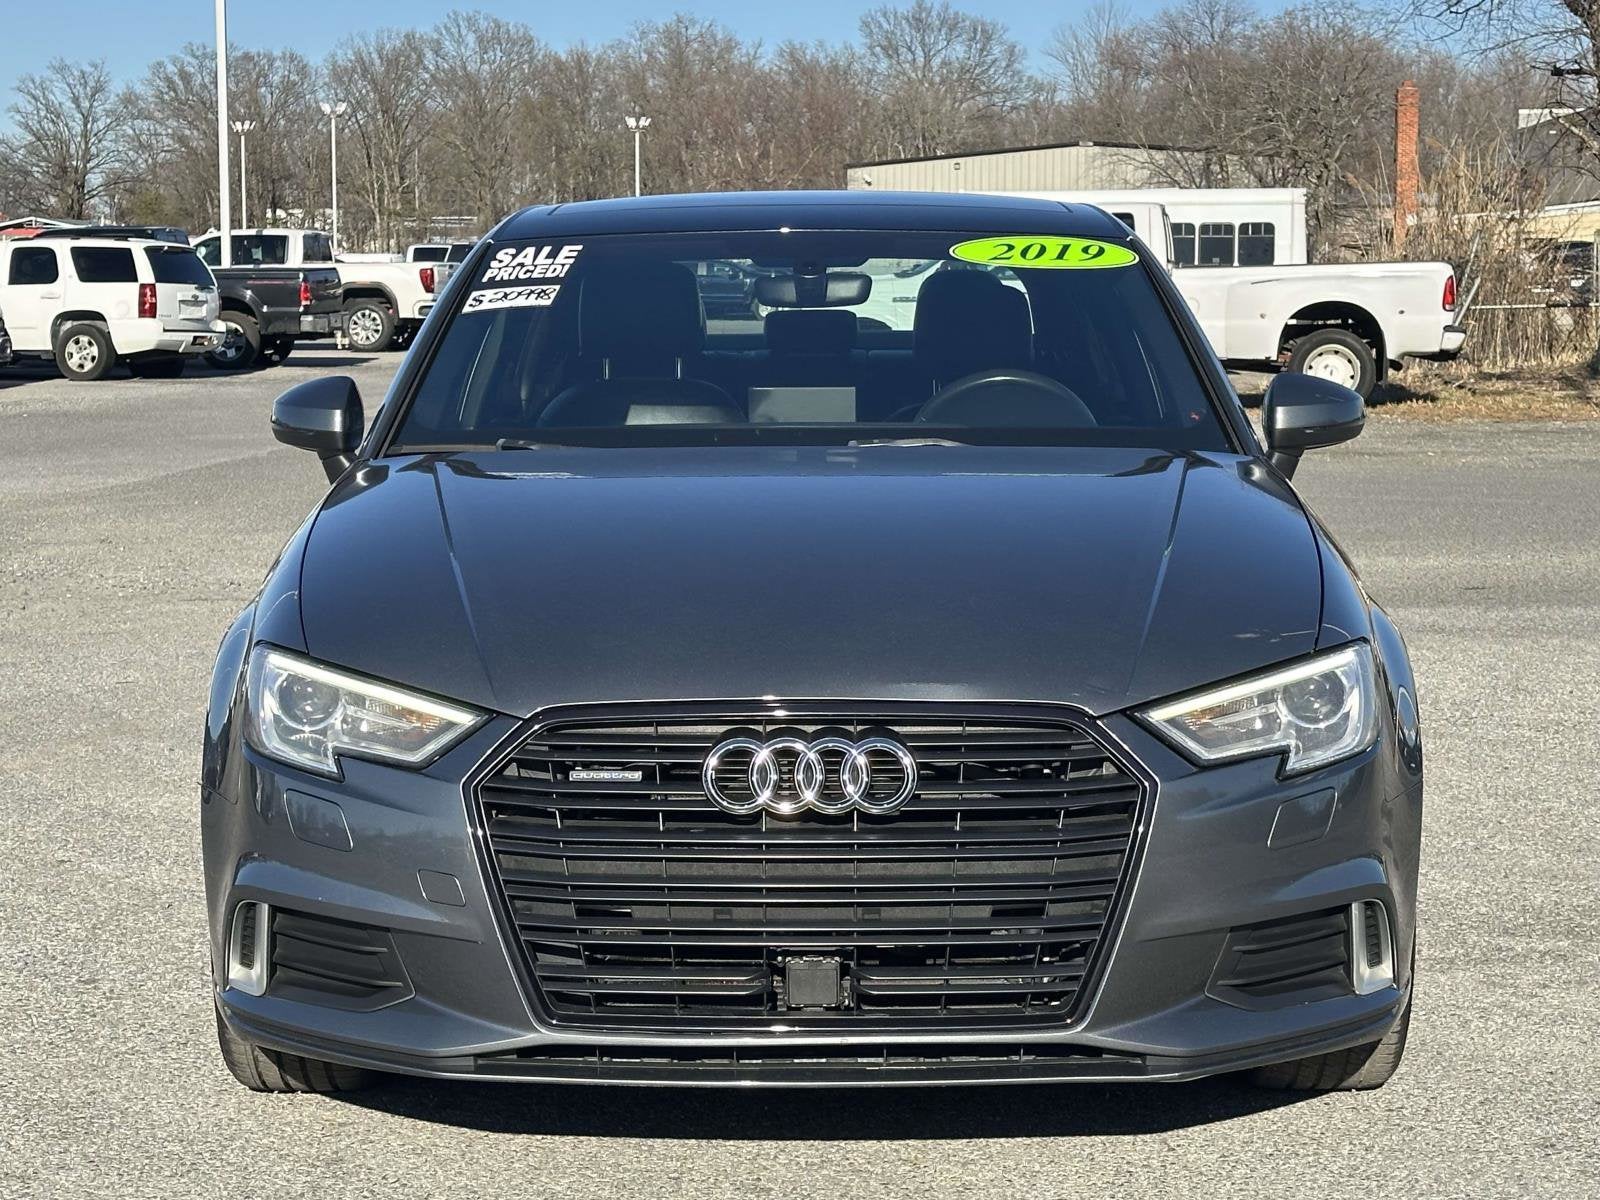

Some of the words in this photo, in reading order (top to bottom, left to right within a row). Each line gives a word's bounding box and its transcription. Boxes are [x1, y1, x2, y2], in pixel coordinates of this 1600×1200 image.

[489, 244, 584, 269] SALE
[988, 242, 1106, 262] 2019
[481, 263, 571, 283] PRICED!
[571, 772, 640, 780] quattro
